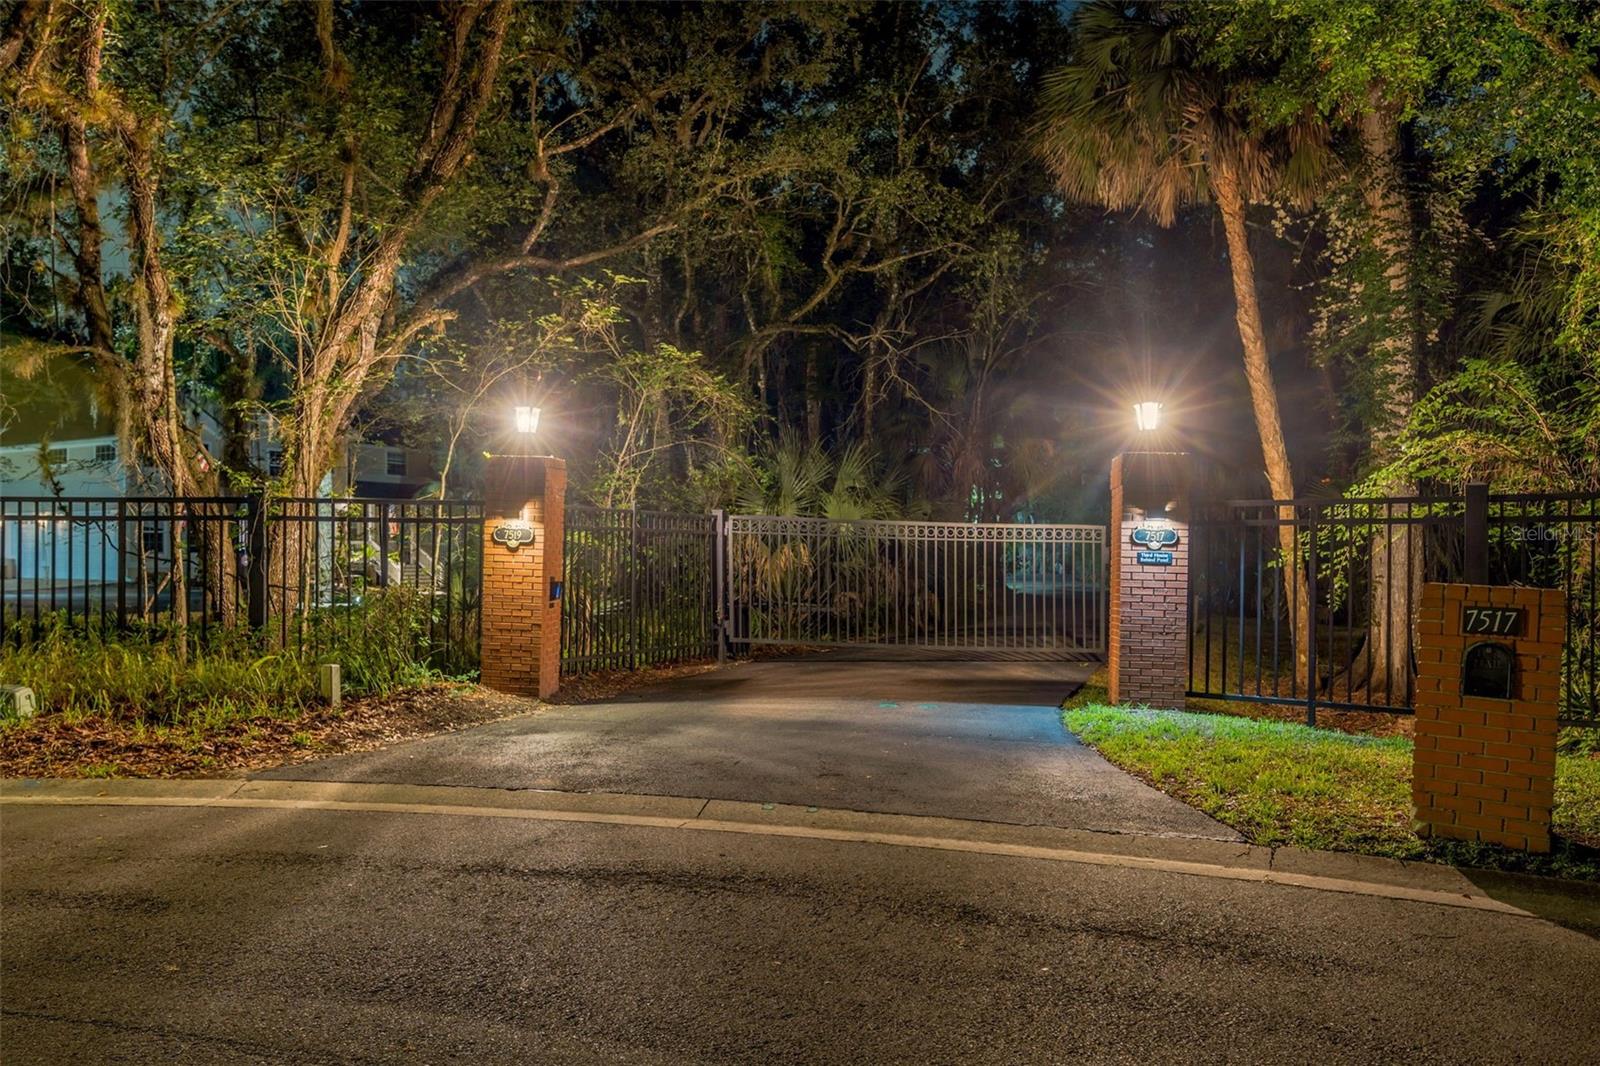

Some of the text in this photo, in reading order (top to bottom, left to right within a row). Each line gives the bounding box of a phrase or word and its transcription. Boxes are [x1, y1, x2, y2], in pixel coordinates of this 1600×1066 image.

[504, 529, 522, 540] 7519
[1145, 531, 1165, 541] 7517
[1466, 609, 1518, 633] 7517
